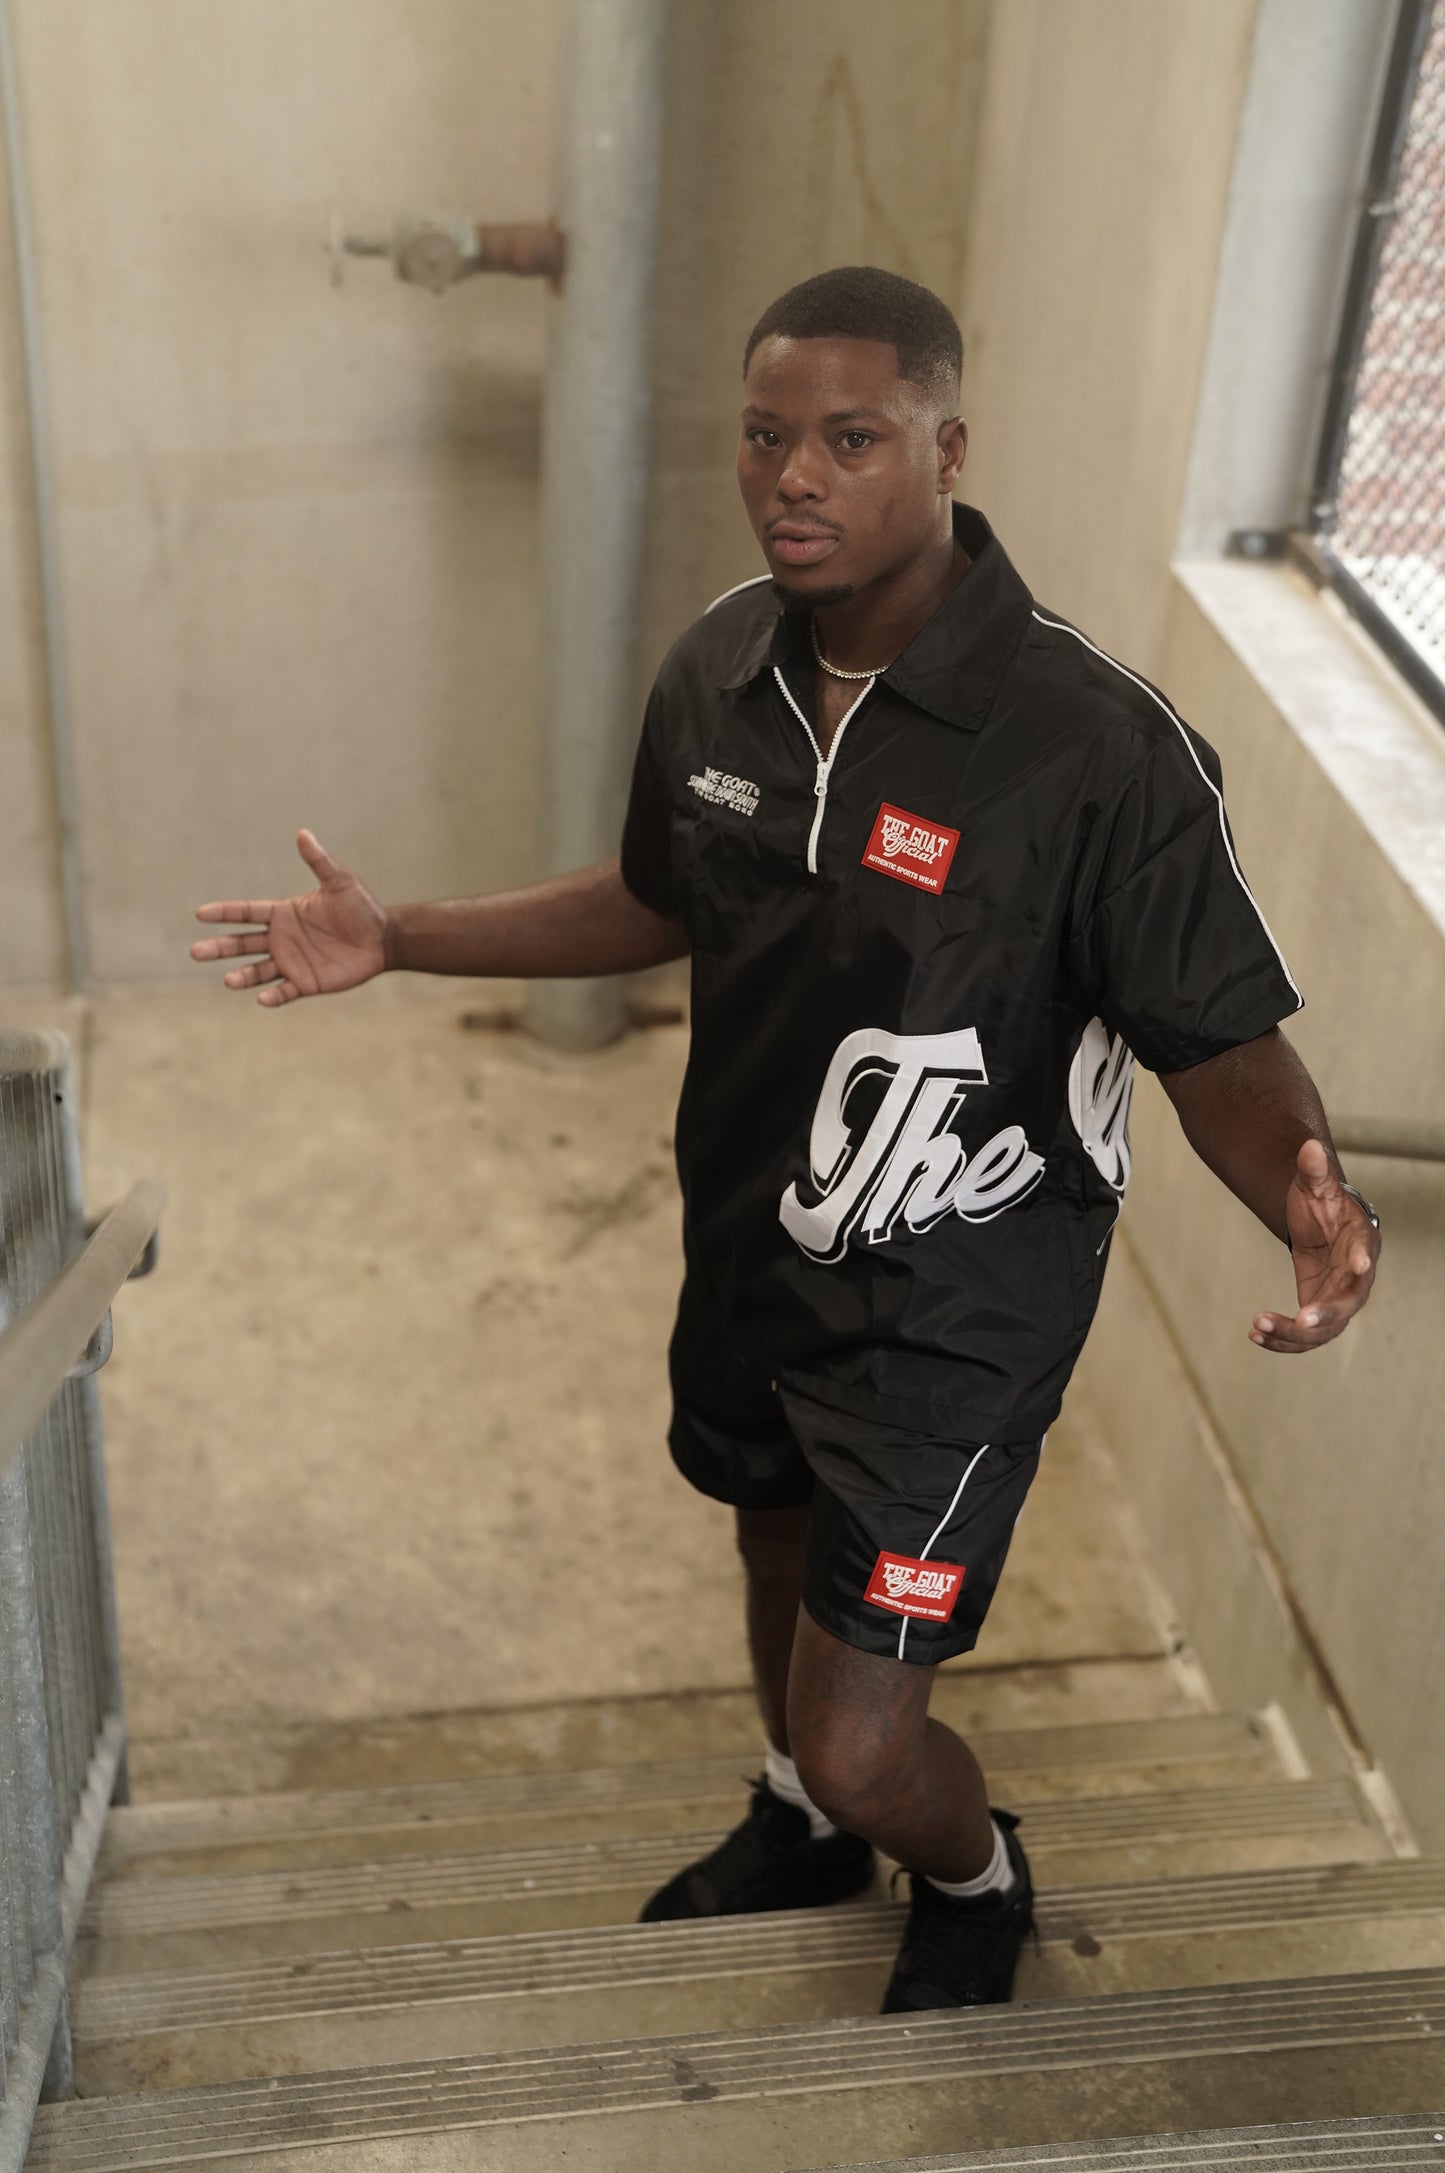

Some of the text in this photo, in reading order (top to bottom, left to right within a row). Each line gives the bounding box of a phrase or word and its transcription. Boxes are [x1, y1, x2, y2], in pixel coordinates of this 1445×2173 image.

[881, 814, 949, 858] THE GOAT
[882, 831, 939, 864] Official
[867, 854, 938, 887] AUTHENTIC SPORTS WEAR
[778, 1026, 1047, 1265] The
[883, 1562, 957, 1592] THE GOAT
[885, 1576, 946, 1600] Official
[870, 1592, 947, 1617] AUTHENTIC SPORTS WEAR
